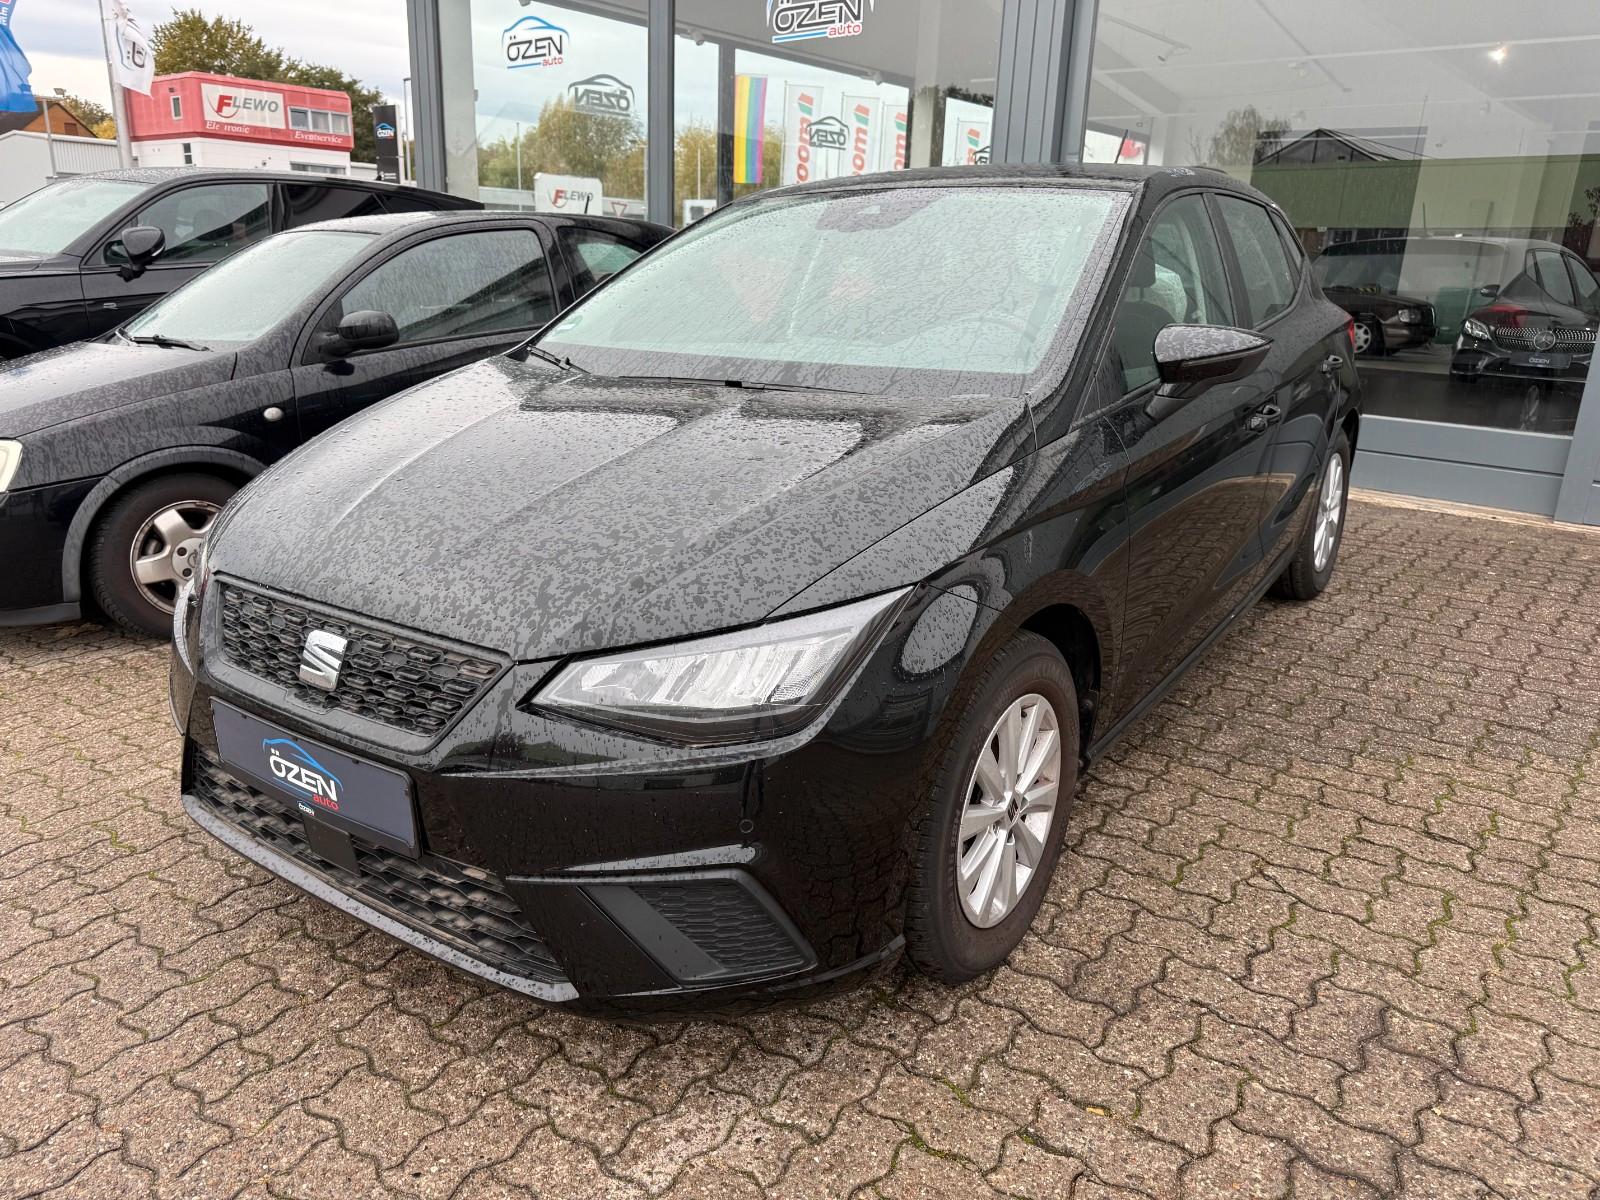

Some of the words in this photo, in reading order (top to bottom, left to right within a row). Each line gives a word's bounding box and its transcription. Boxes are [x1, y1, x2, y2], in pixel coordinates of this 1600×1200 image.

[828, 23, 862, 37] auto
[506, 35, 564, 62] ÖZEN
[541, 56, 564, 67] auto
[215, 94, 279, 114] FLEWO
[295, 131, 344, 144] Eventservice
[552, 189, 594, 204] FLEWO
[269, 748, 338, 802] ÖZEN
[312, 793, 339, 811] auto
